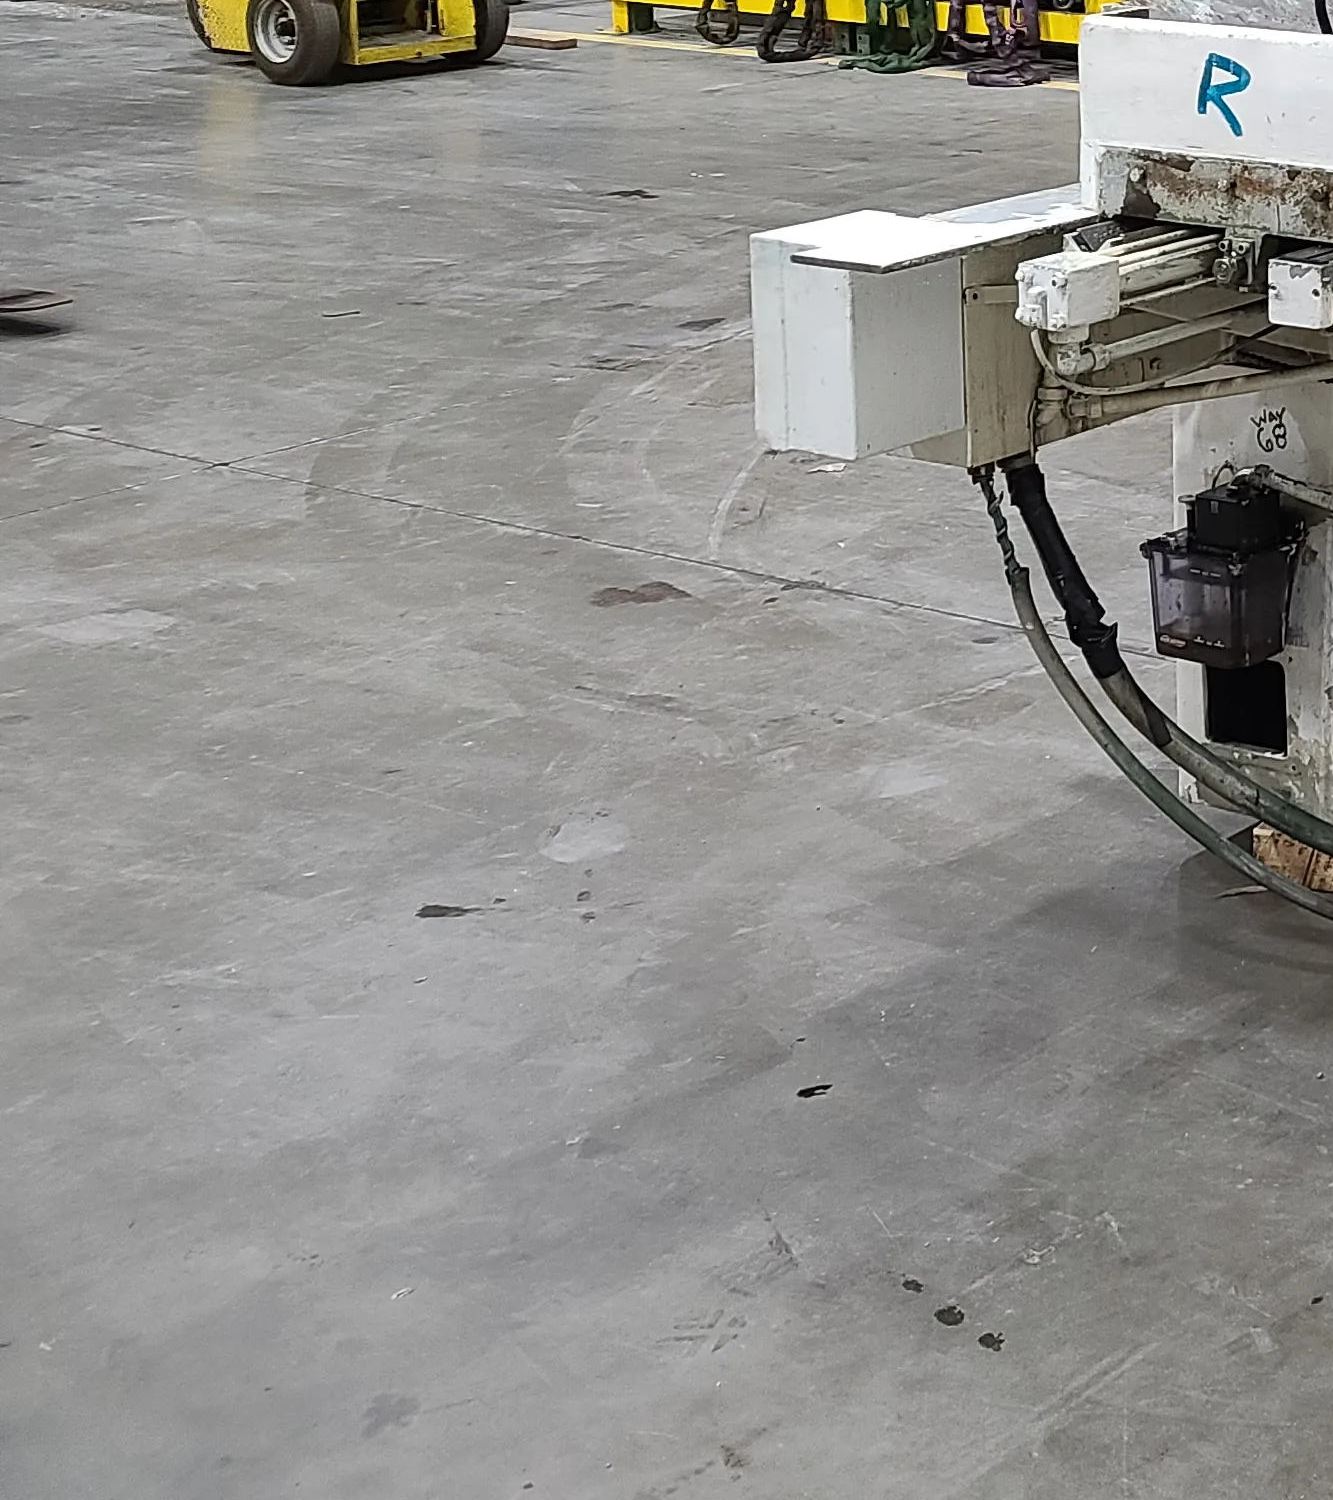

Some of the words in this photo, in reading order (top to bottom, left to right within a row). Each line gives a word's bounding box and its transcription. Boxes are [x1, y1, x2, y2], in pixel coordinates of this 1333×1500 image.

[1198, 53, 1251, 137] R
[1250, 407, 1286, 428] WAY
[1257, 423, 1287, 452] 68
